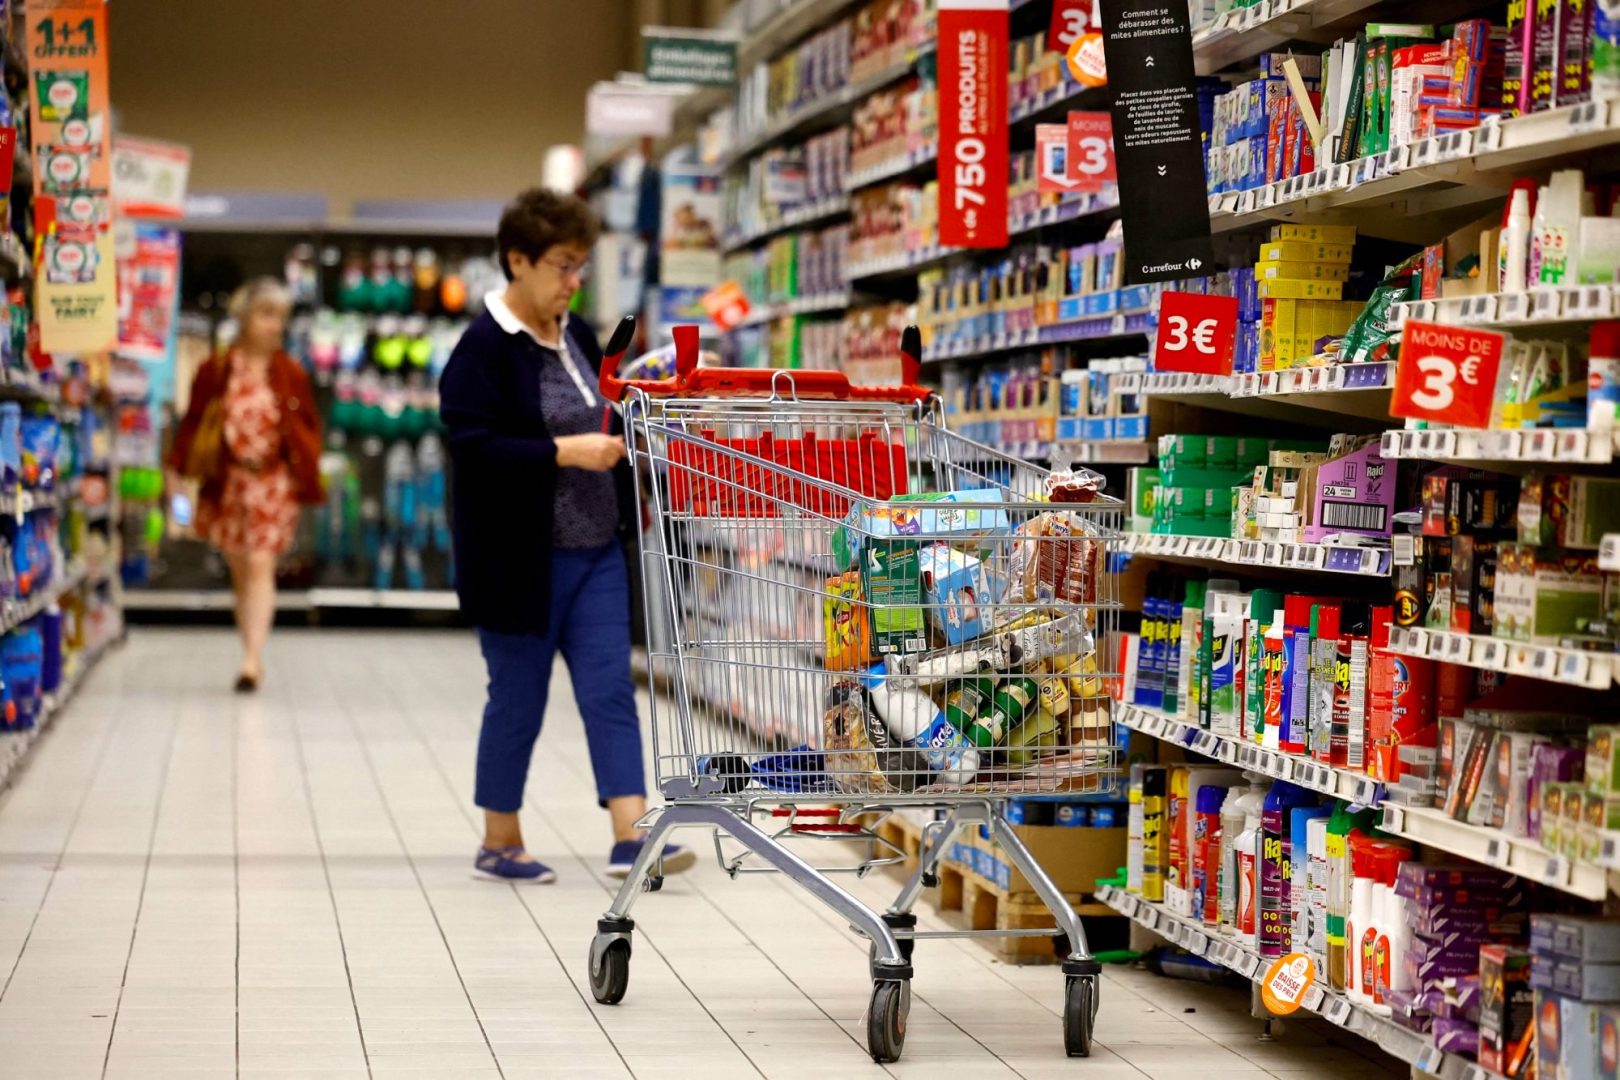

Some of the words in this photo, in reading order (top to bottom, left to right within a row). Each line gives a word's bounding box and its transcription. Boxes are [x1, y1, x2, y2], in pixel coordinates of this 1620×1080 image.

[1122, 8, 1158, 19] Comment
[1118, 19, 1160, 29] débarasser
[36, 17, 96, 45] 1+1
[1110, 31, 1132, 40] mites
[1133, 26, 1179, 38] alimentaires
[1180, 25, 1185, 33] ?
[35, 46, 97, 58] OFFERT
[958, 29, 977, 134] PRODUITS
[1163, 86, 1187, 95] placards
[1173, 93, 1194, 101] garnies
[1135, 110, 1155, 118] feuilles
[1160, 128, 1191, 136] repoussent
[954, 137, 986, 210] 750
[1142, 262, 1182, 274] Carrefour
[55, 306, 97, 319] FAIRY
[1164, 315, 1218, 354] 3€
[1411, 329, 1465, 352] MOINS
[1469, 338, 1492, 355] DE
[1410, 355, 1482, 410] 3€
[1366, 465, 1384, 477] Raid
[1324, 486, 1336, 496] 24
[1277, 971, 1301, 991] BAISSE
[1272, 980, 1283, 991] DES
[1282, 987, 1296, 999] PRIX
